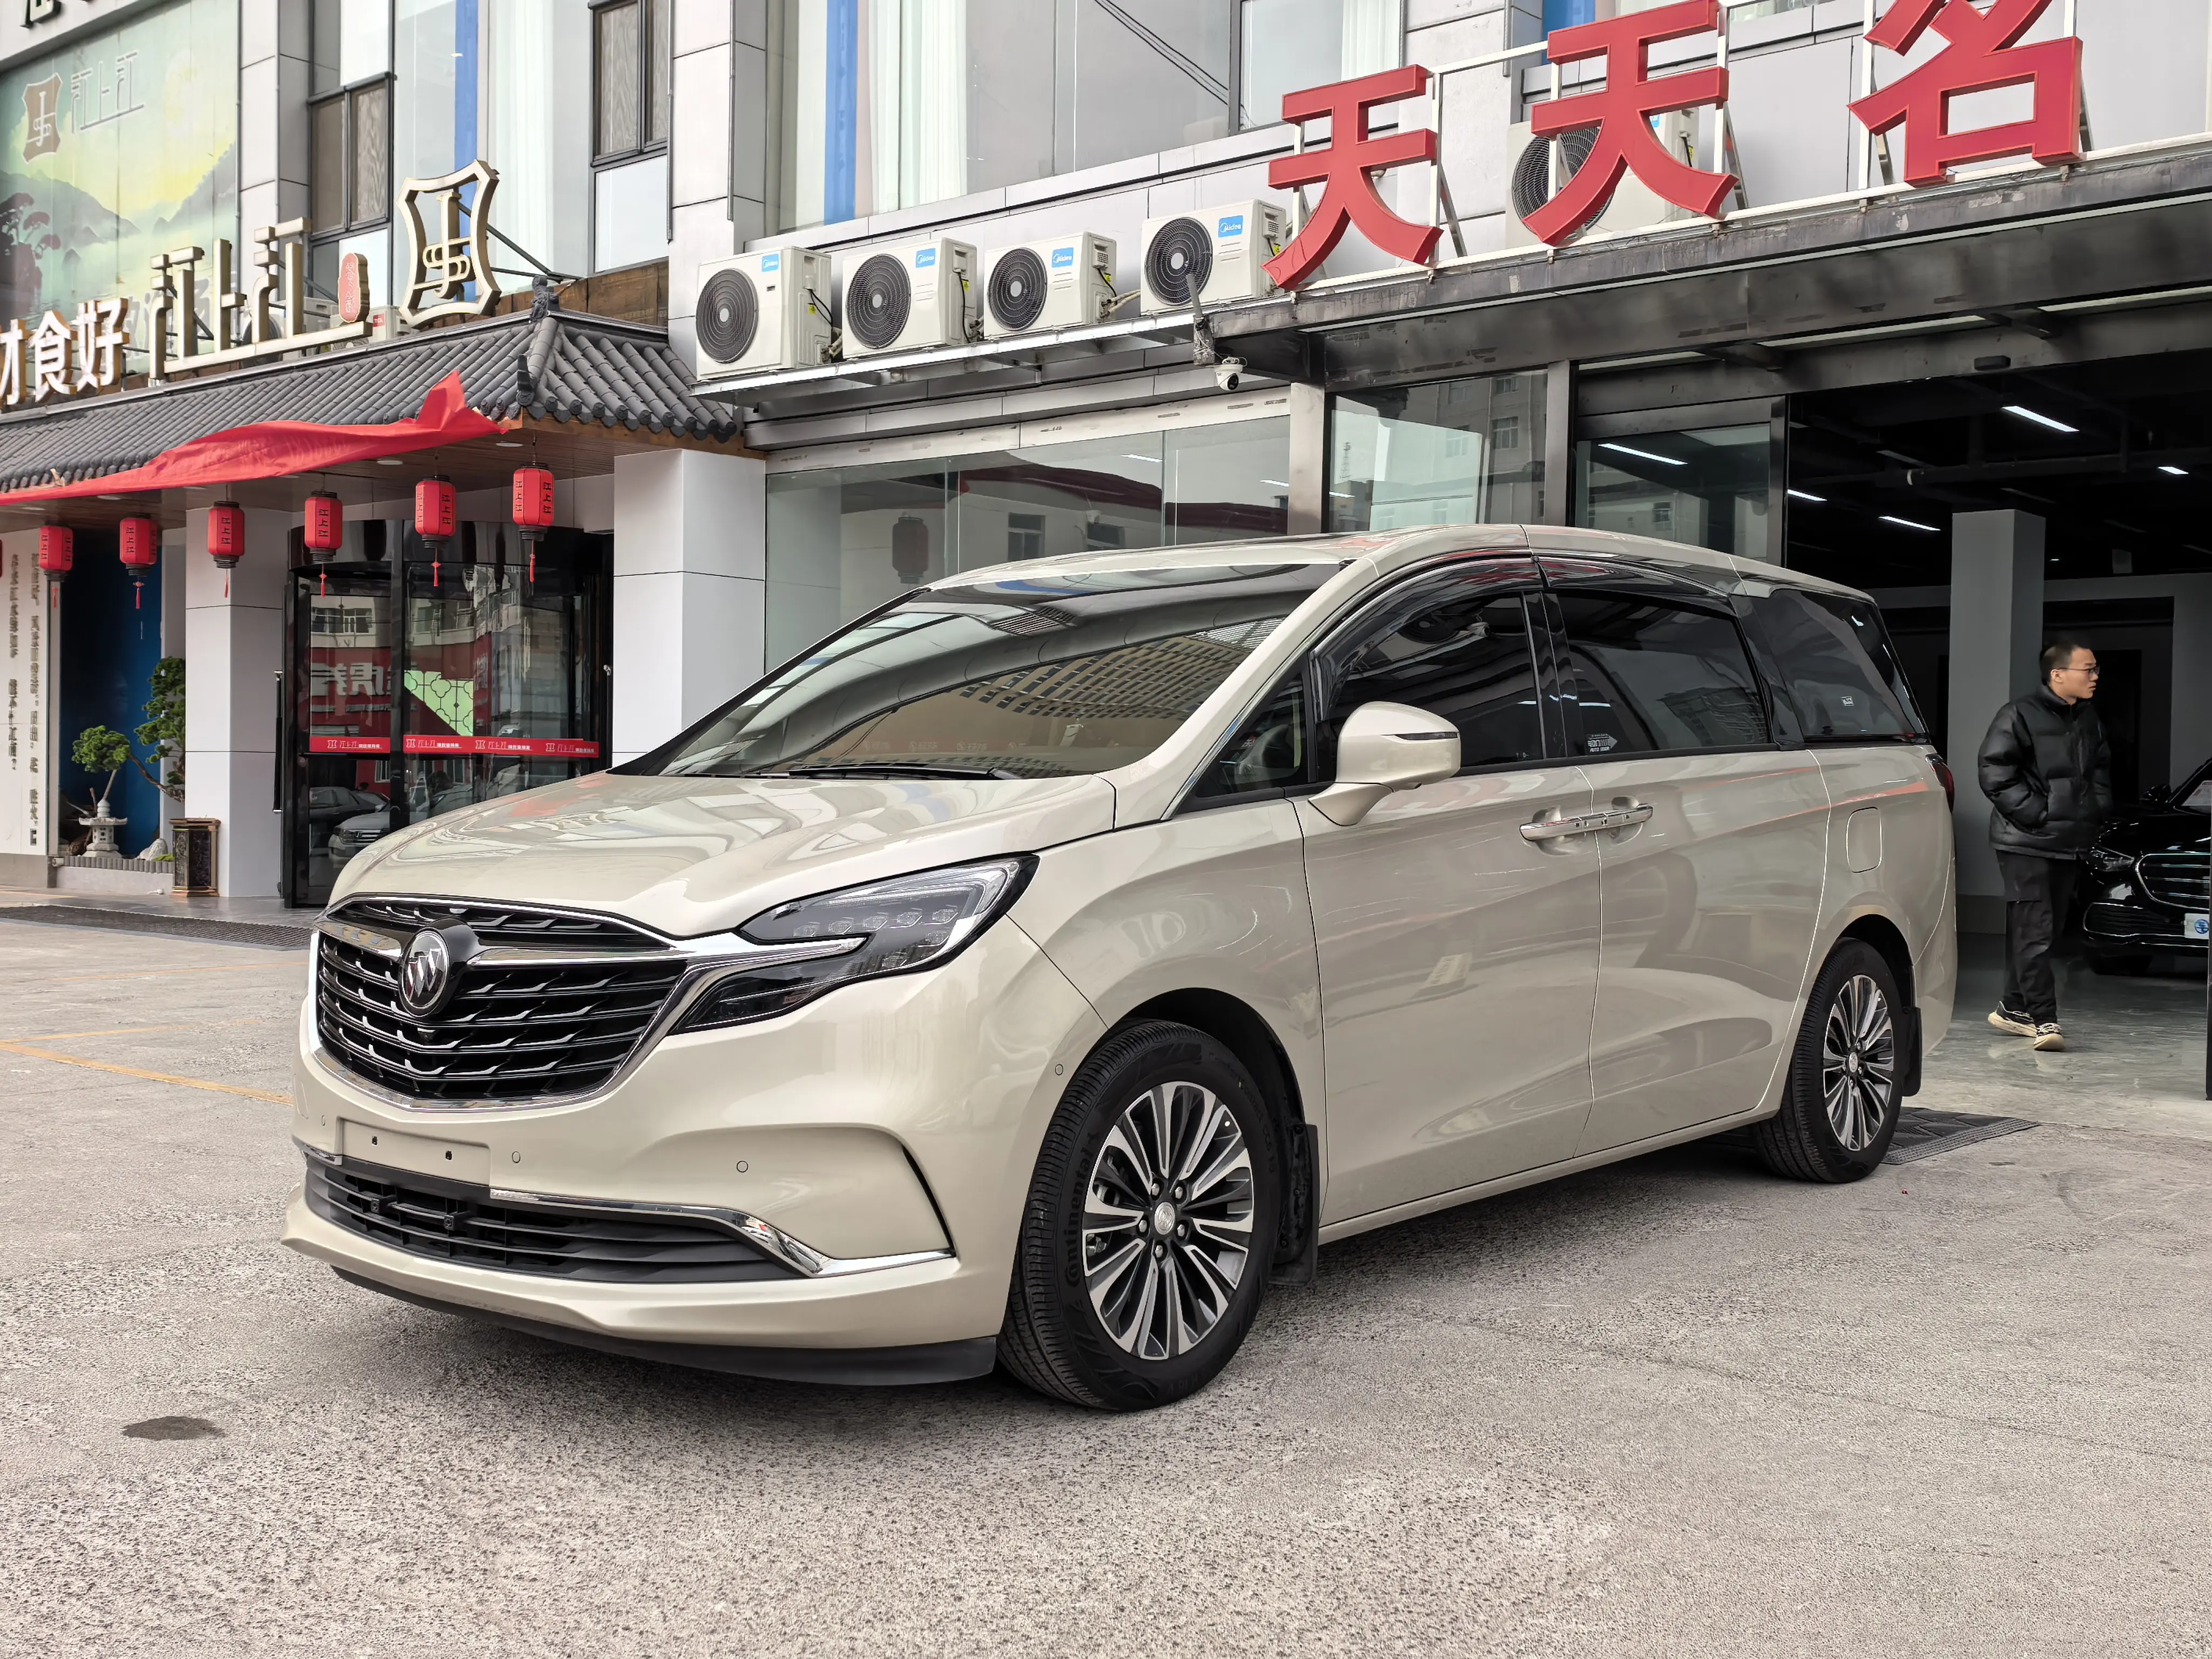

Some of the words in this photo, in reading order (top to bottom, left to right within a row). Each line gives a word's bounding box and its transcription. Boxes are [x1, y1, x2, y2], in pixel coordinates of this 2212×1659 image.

[1262, 0, 2083, 289] 天天名
[1219, 223, 1242, 232] Midea
[916, 255, 934, 264] Midea
[1053, 253, 1073, 263] Midea
[1064, 1147, 1094, 1287] Continental
